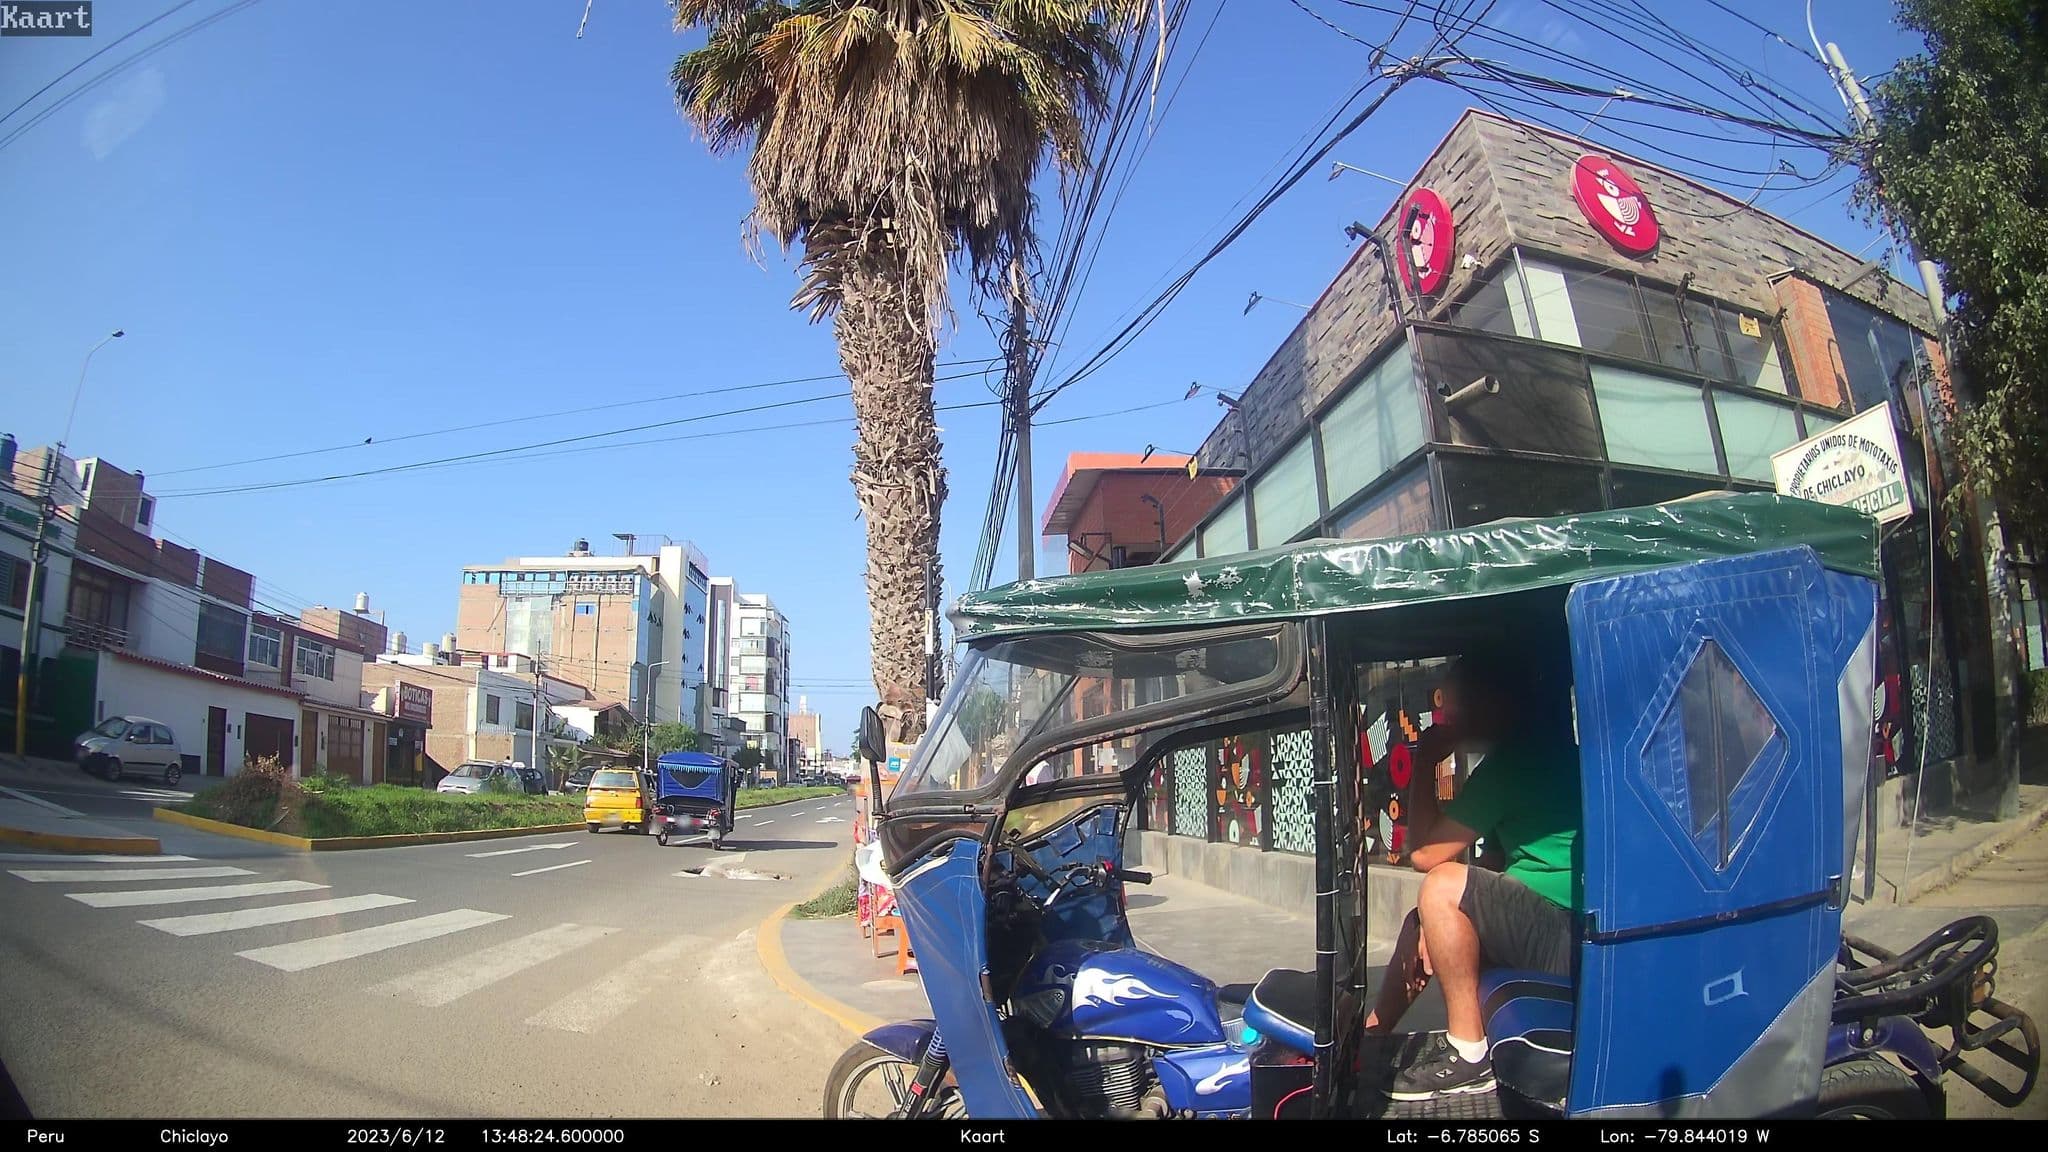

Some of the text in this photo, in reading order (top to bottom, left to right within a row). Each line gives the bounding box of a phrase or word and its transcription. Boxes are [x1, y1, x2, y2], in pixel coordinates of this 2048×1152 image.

[1790, 434, 1898, 496] PROPIETARIOS UNIDOS DE MOTOTAXIS
[1803, 464, 1865, 500] DE CHICLAYO
